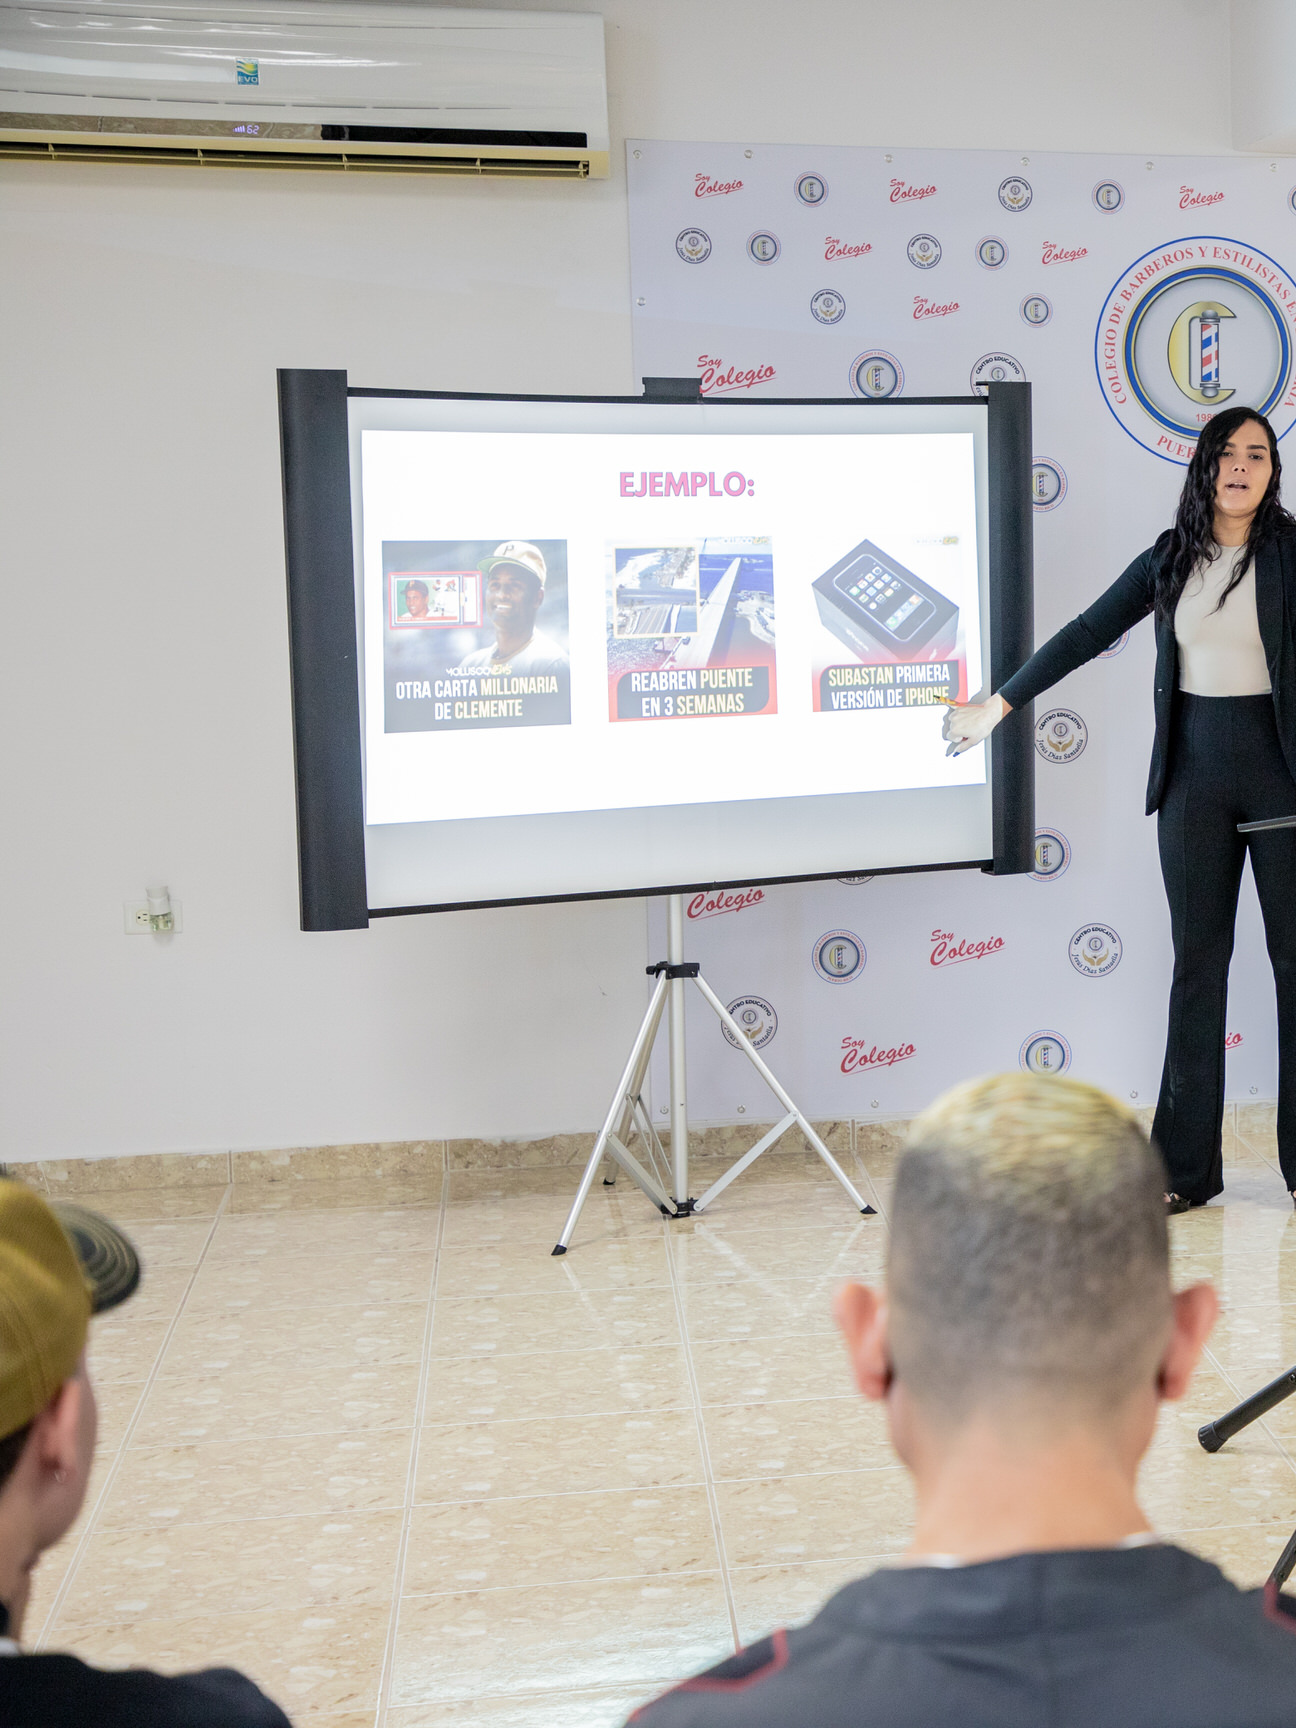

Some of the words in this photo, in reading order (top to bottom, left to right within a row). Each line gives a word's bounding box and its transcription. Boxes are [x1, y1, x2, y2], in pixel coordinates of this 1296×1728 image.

[695, 181, 743, 198] Colegio
[890, 185, 936, 203] Colegio
[1179, 192, 1224, 209] Colegio
[825, 243, 872, 260] Colegio
[1042, 248, 1087, 264] Colegio
[1198, 246, 1208, 258] Y
[1120, 247, 1194, 302] BARBEROS
[1213, 246, 1291, 300] ESTILISTAS
[913, 303, 960, 319] Colegio
[1109, 302, 1126, 325] DE
[697, 355, 722, 369] Soy
[1104, 329, 1127, 404] COLEGIO
[699, 364, 776, 394] Colegio
[1157, 435, 1197, 459] PUER
[620, 471, 755, 497] EJEMPLO:
[631, 670, 697, 692] REABREN
[700, 668, 753, 689] PUENTE
[828, 667, 893, 686] SUBASTAN
[896, 664, 950, 683] PRIMERA
[396, 681, 431, 699] OTRA
[434, 679, 478, 698] CARTA
[480, 676, 558, 696] MILLONARIA
[831, 686, 884, 709] VERSIÓN
[887, 689, 903, 707] DE
[434, 702, 452, 720] DE
[454, 699, 523, 719] CLEMENTE
[641, 697, 661, 717] EN
[664, 696, 674, 716] 3
[676, 693, 745, 716] SEMANAS
[687, 888, 764, 918] Colegio
[931, 929, 954, 942] Soy
[930, 937, 1004, 966] Colegio
[728, 1000, 745, 1015] ENTRO
[841, 1037, 865, 1049] Soy
[841, 1043, 916, 1073] Colegio
